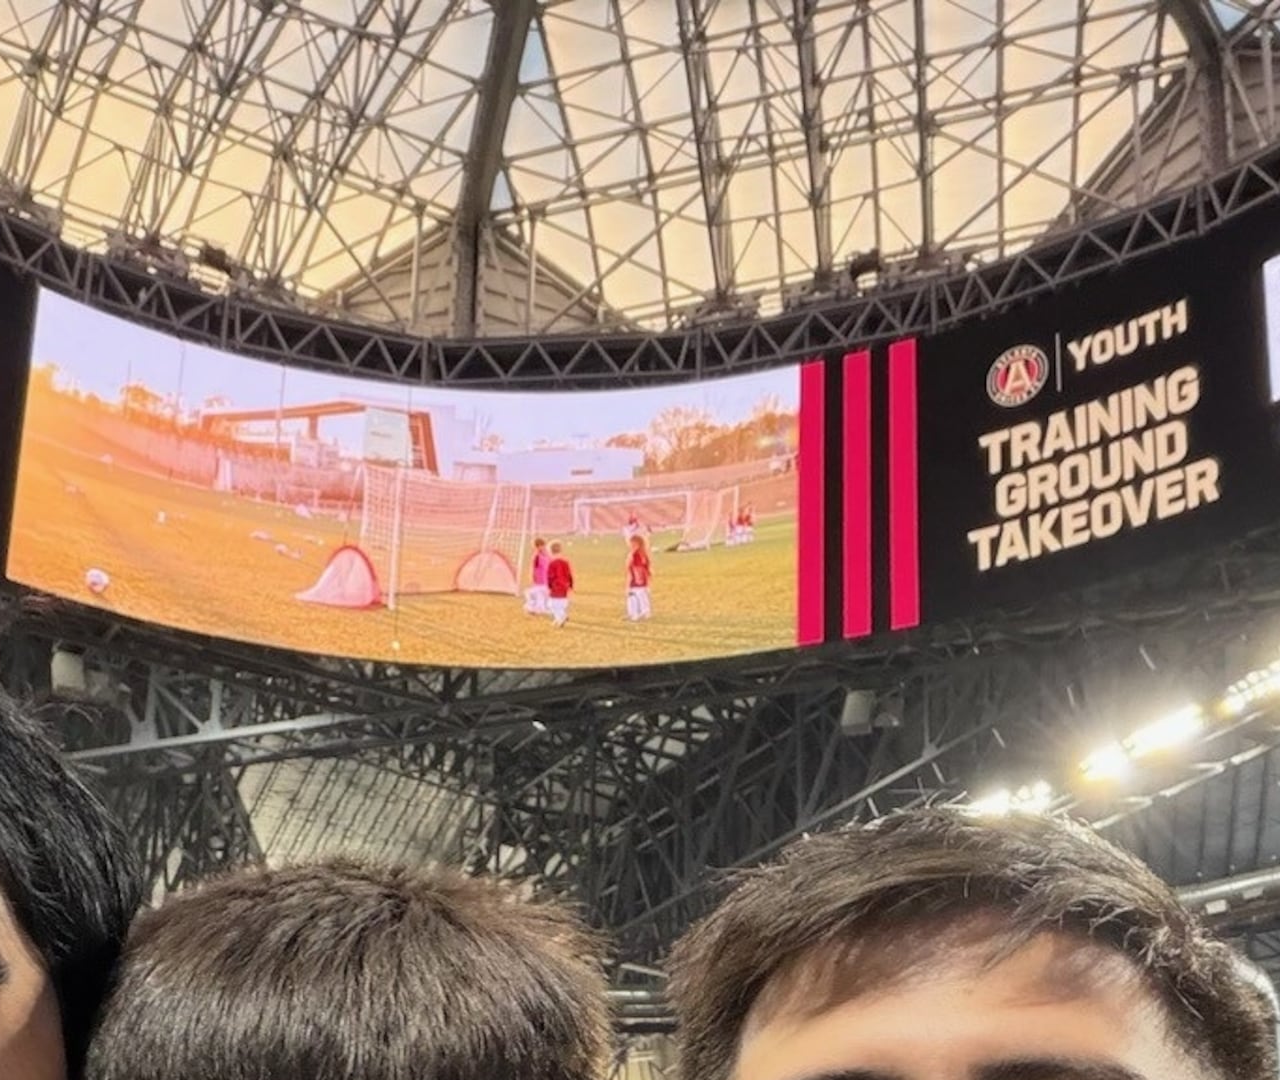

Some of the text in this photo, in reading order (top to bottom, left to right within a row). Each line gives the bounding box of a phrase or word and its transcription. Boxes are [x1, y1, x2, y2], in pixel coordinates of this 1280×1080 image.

[1066, 299, 1188, 374] YOUTH
[979, 363, 1200, 475] TRAINING
[994, 418, 1188, 519] GROUND
[967, 456, 1220, 572] TAKEOVER
